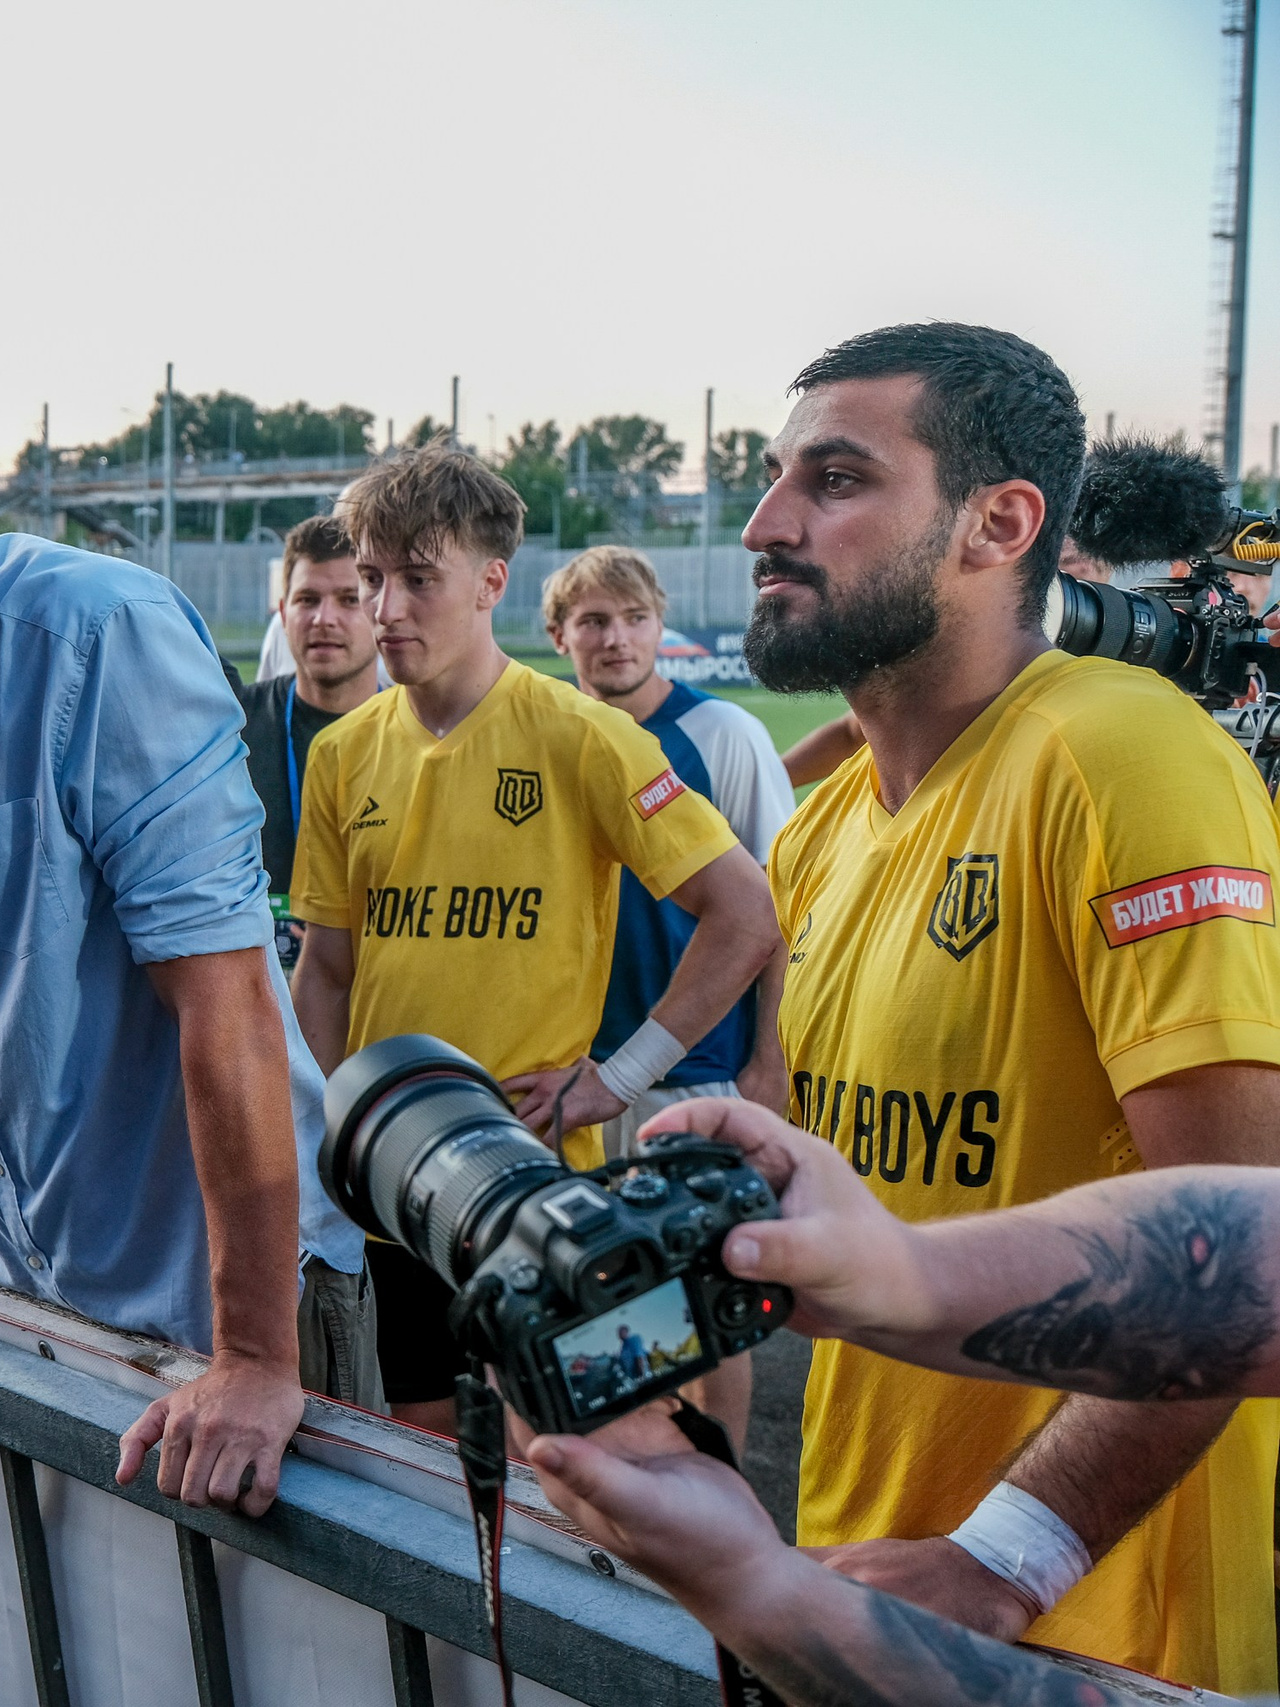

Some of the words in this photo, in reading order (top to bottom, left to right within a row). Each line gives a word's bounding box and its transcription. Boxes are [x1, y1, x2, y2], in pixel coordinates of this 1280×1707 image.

[639, 777, 672, 811] БУДЕТ
[352, 818, 388, 831] DEMIX
[443, 886, 543, 940] BOYS
[1110, 884, 1184, 931] БУДЕТ
[1188, 877, 1264, 910] ЖАРКО
[851, 1084, 1000, 1188] BOYS
